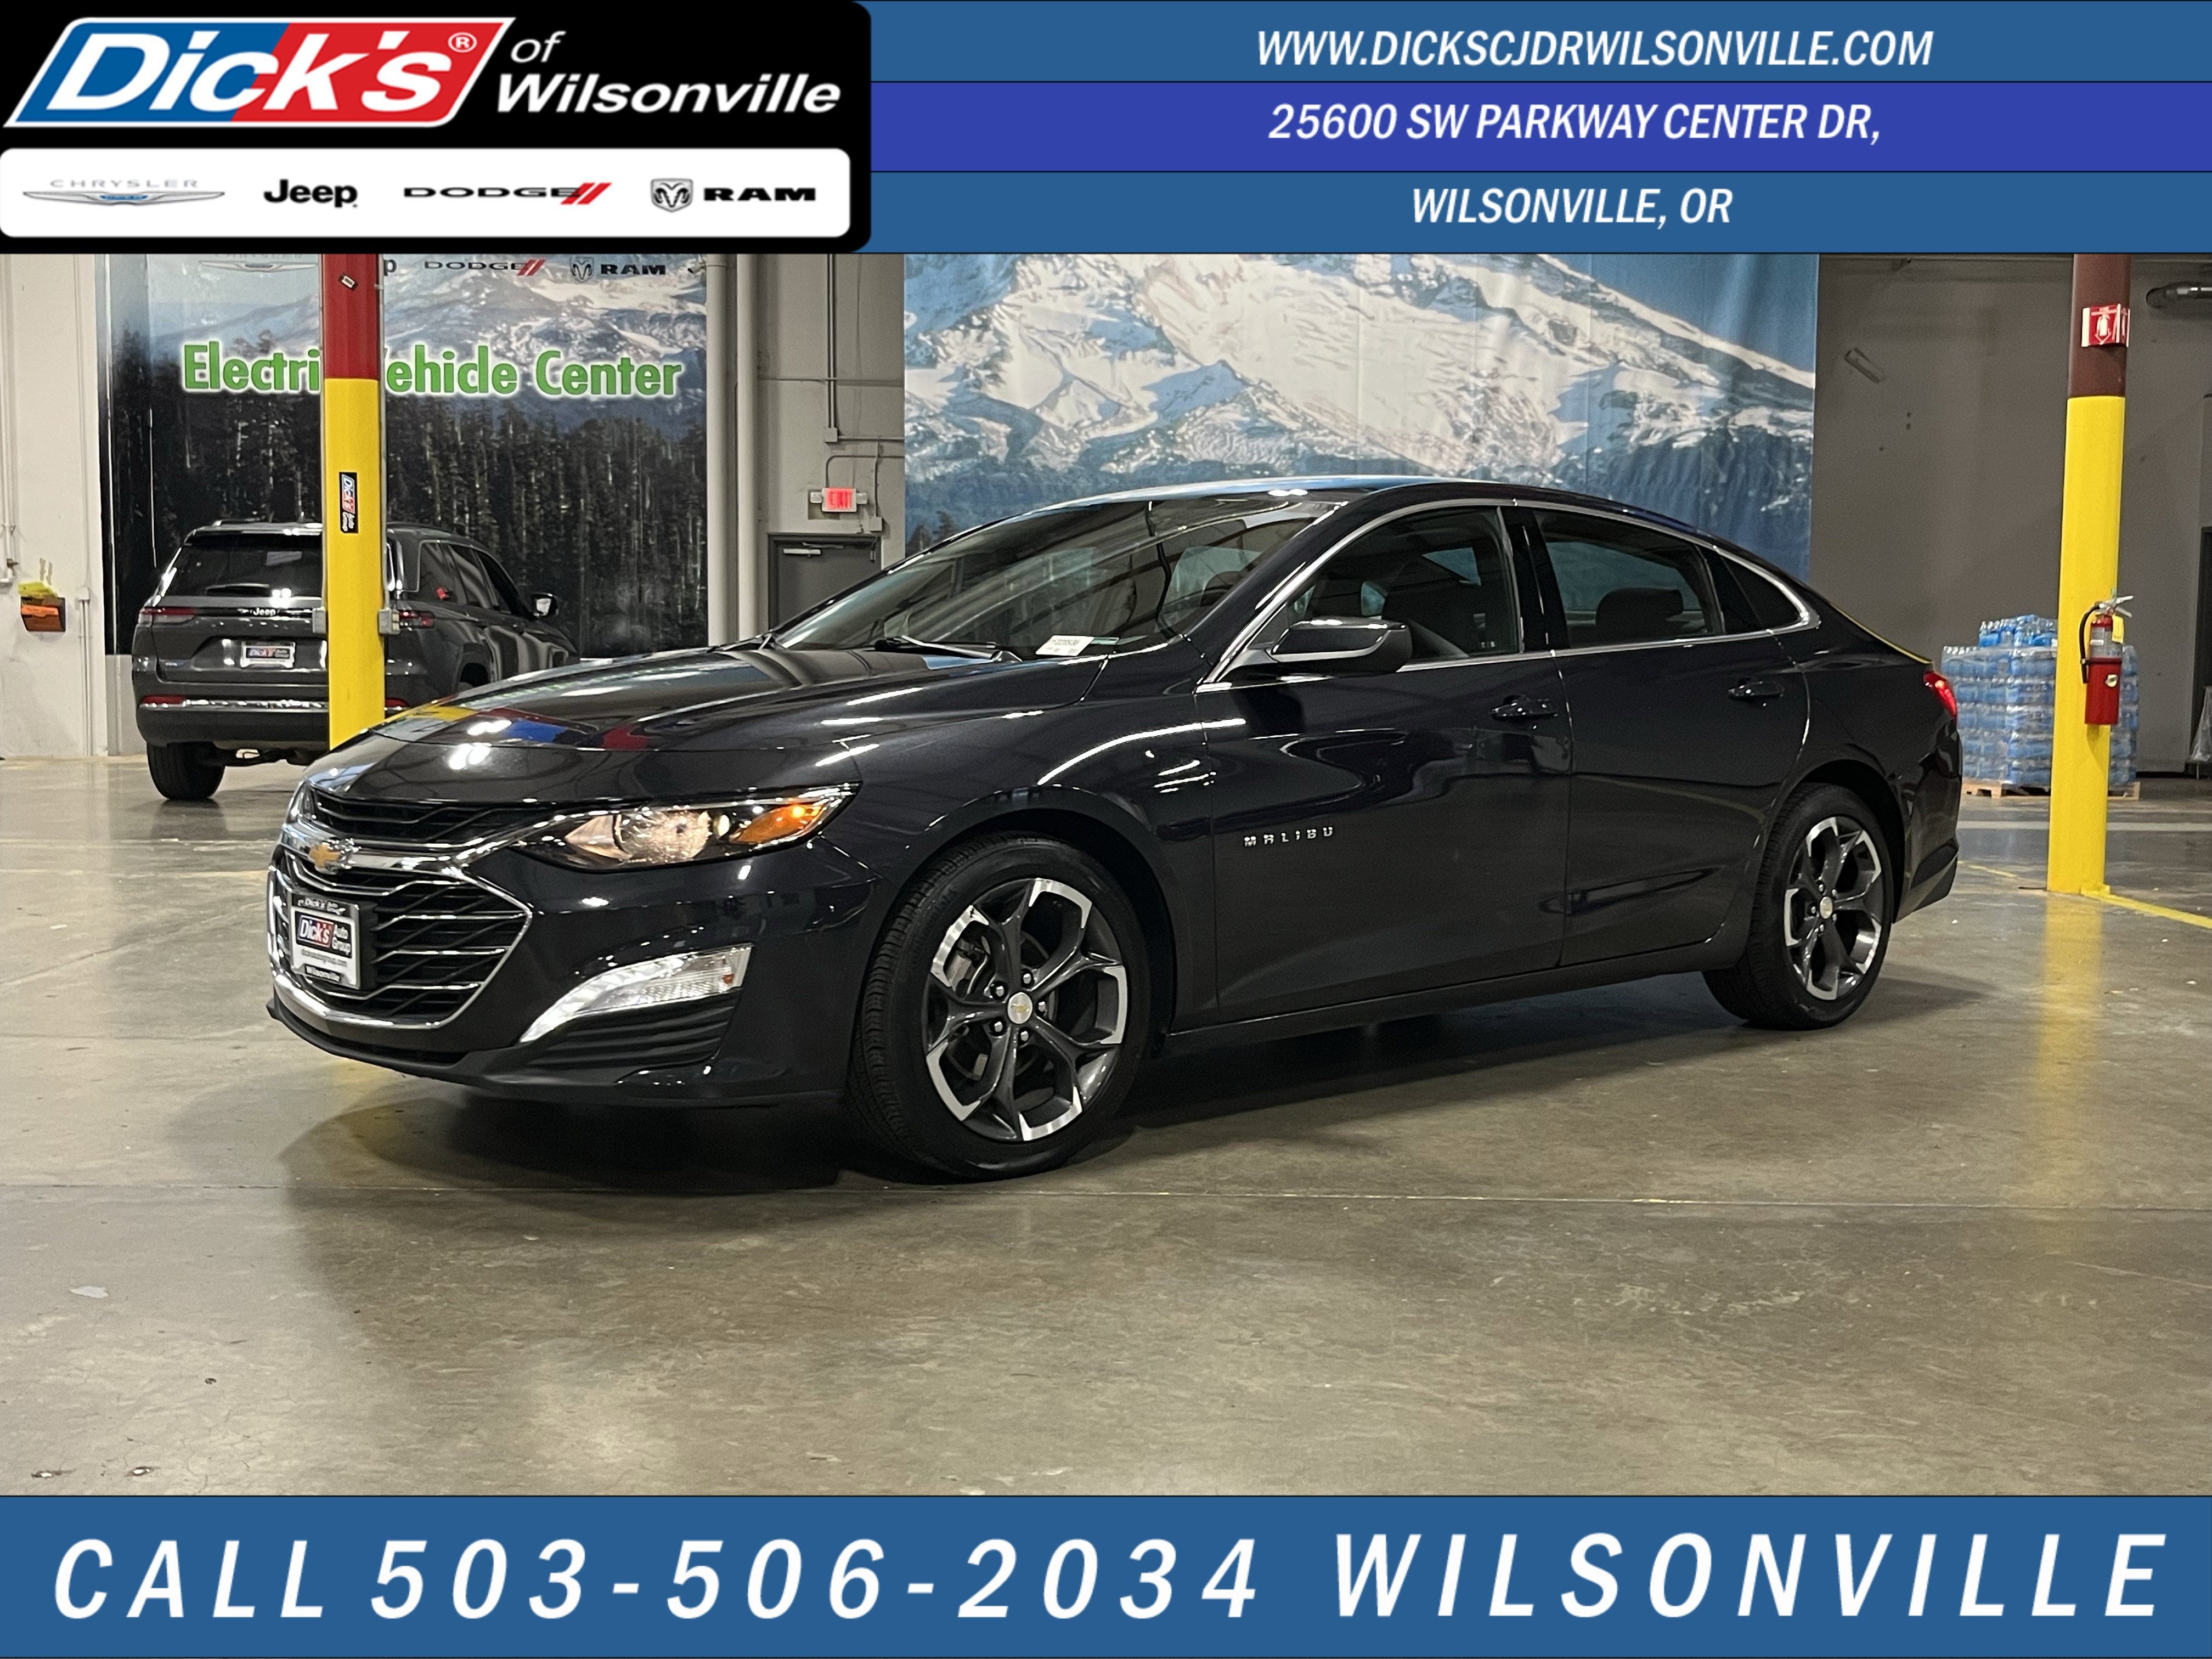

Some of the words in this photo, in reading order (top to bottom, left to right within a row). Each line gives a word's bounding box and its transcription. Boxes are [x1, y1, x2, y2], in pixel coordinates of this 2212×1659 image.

[424, 261, 527, 270] DODGE
[600, 263, 667, 275] RAM
[184, 341, 320, 391] Electri
[384, 345, 517, 394] ehicle
[535, 350, 681, 396] Center
[253, 607, 276, 617] Jeep
[1244, 827, 1333, 847] MALIBU
[300, 918, 331, 944] Dick's
